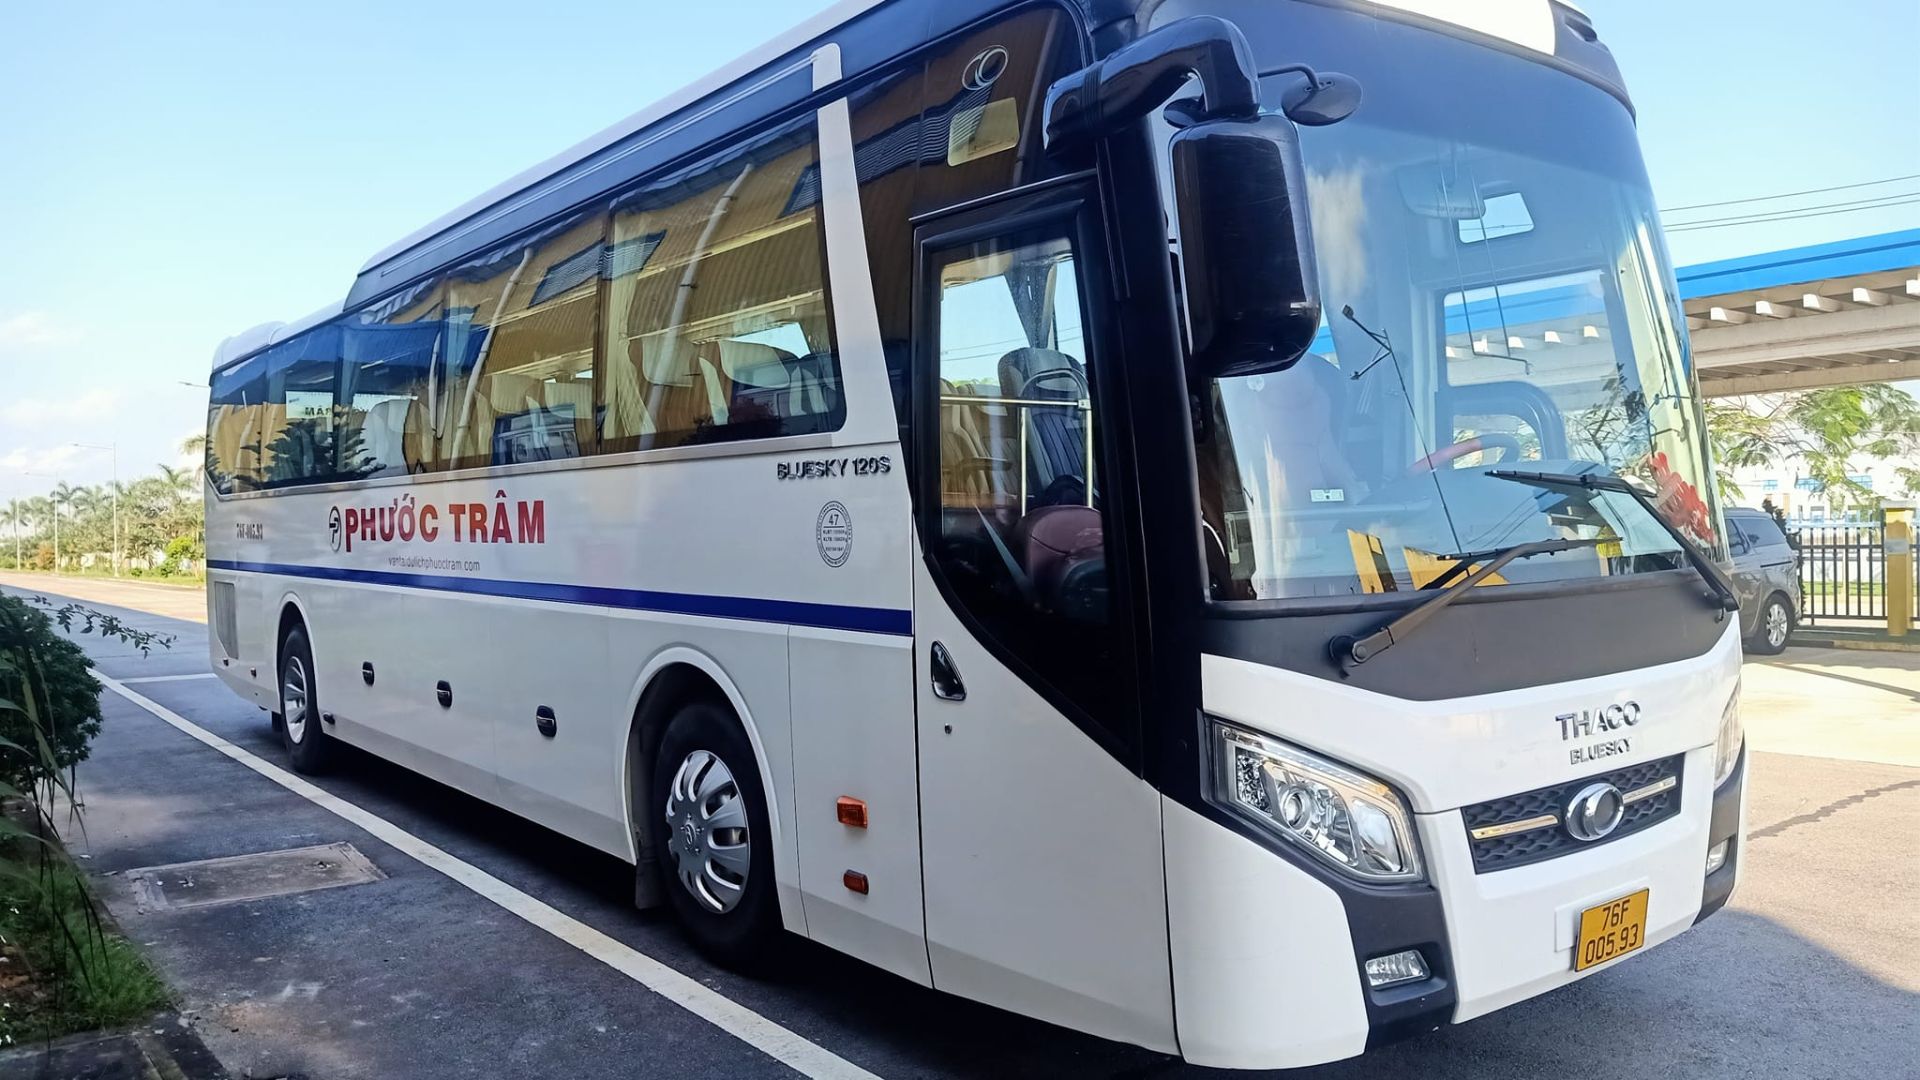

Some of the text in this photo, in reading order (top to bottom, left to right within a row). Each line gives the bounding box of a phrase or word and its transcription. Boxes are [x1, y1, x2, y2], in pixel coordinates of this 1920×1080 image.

[777, 456, 891, 480] BLUESKY 120S
[345, 489, 545, 553] PHƯỚC TRÂM
[828, 513, 839, 526] 47
[1556, 700, 1641, 741] THACO
[1570, 737, 1632, 765] BLUESKY
[1602, 899, 1631, 932] 76F
[1585, 923, 1639, 965] 005.93
